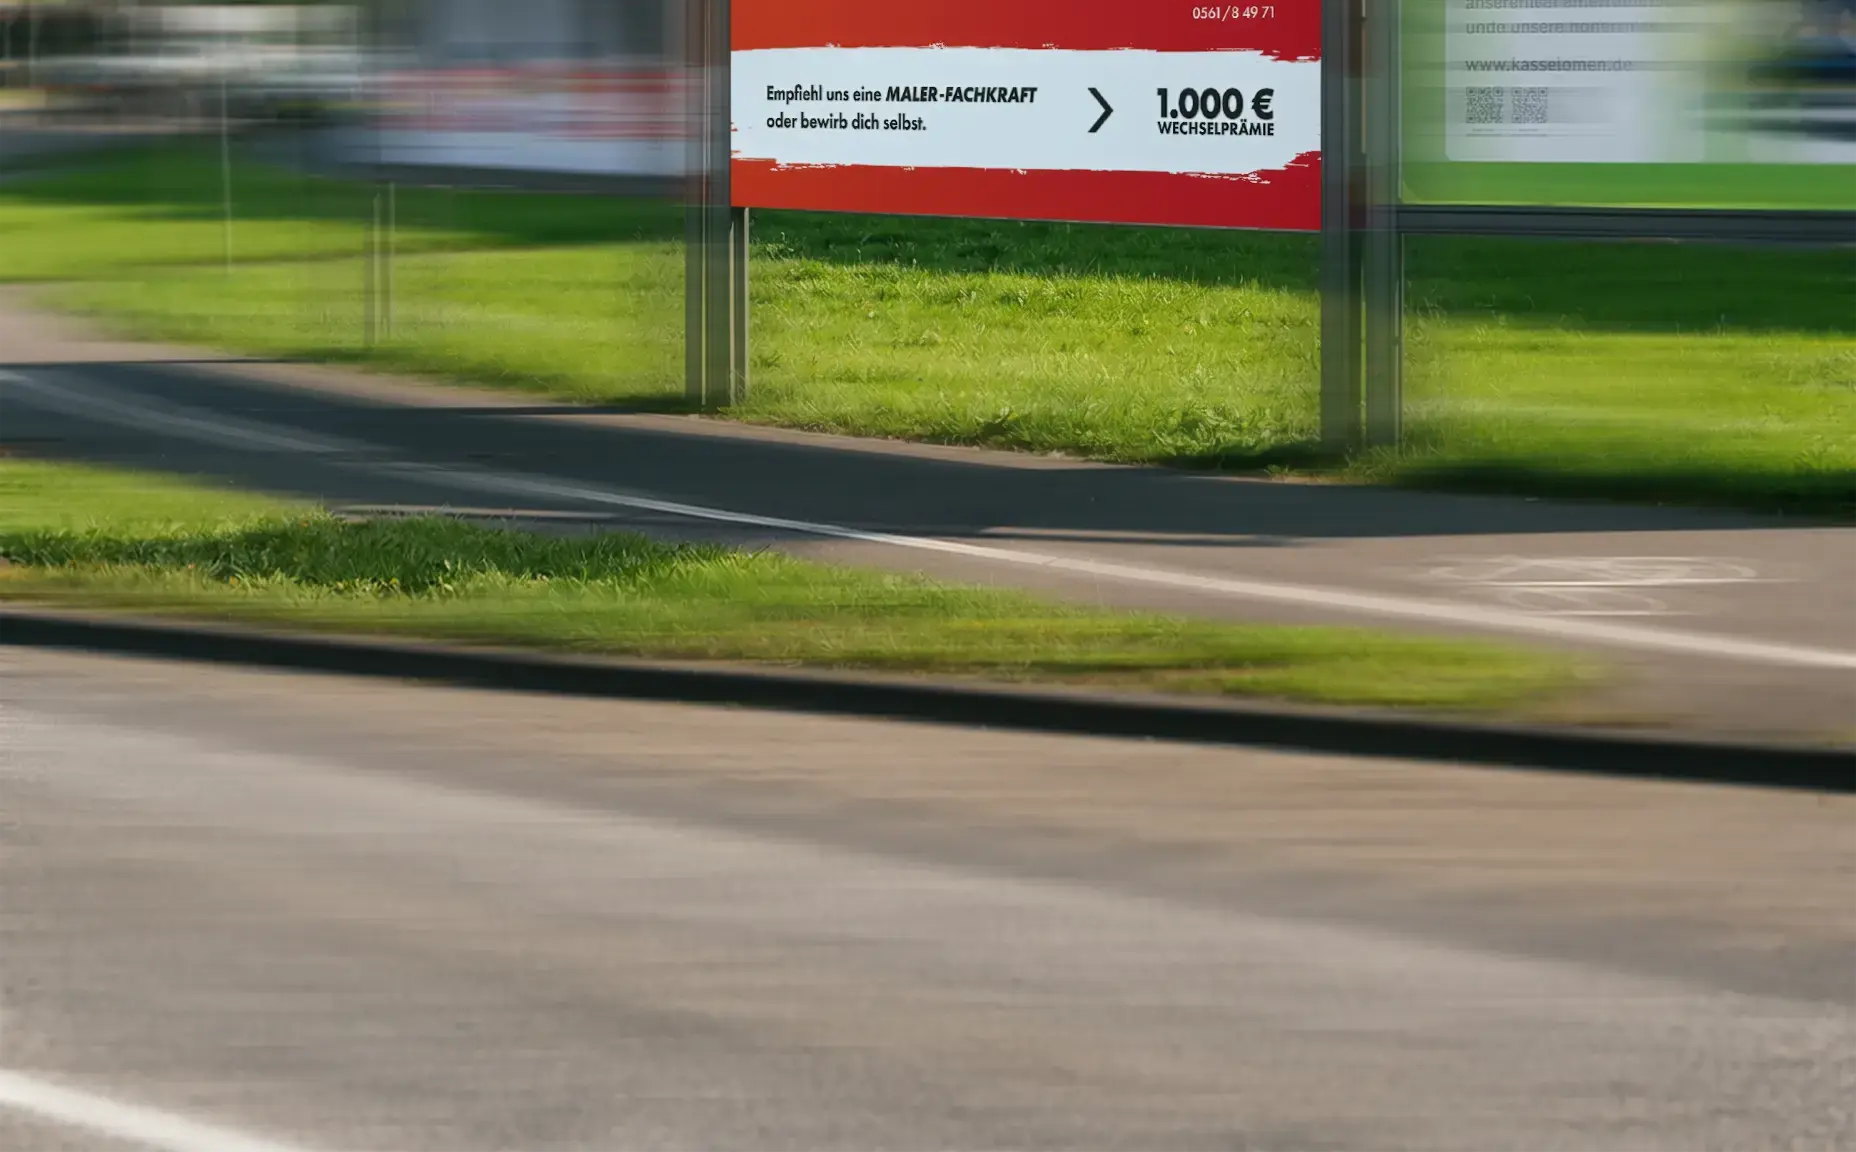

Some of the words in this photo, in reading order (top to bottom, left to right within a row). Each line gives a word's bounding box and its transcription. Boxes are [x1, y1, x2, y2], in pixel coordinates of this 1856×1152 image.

[1192, 5, 1240, 22] 0561/8
[1242, 6, 1258, 19] 49
[1261, 6, 1275, 19] 71
[766, 84, 822, 105] Empfiehl
[826, 87, 849, 101] uns
[852, 86, 882, 102] eine
[885, 86, 1038, 103] MALER-FACHKRAFT
[1157, 87, 1244, 120] 1.000
[1251, 87, 1275, 121] €
[766, 112, 798, 129] oder
[800, 112, 848, 130] bewirb
[851, 113, 879, 130] dich
[883, 114, 927, 131] selbst.
[1157, 119, 1275, 136] WECHSELPRÄMIE
